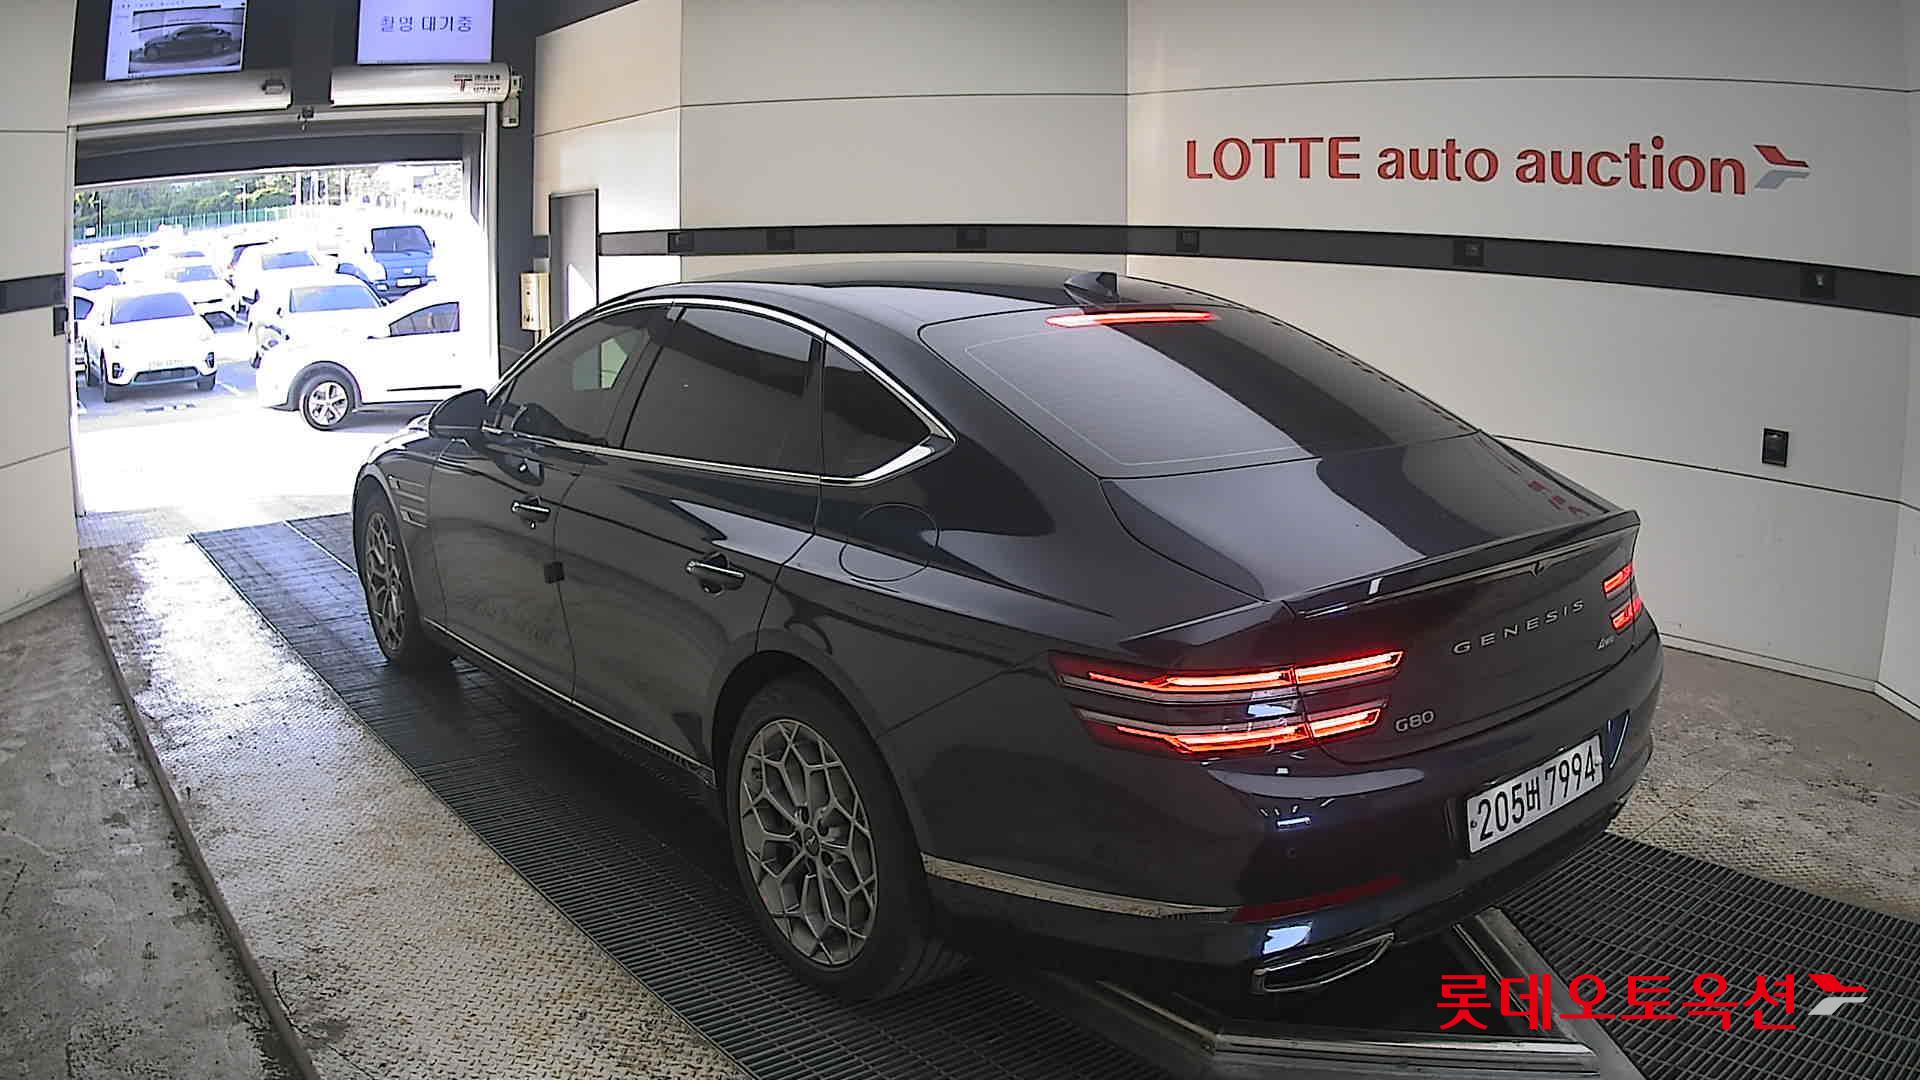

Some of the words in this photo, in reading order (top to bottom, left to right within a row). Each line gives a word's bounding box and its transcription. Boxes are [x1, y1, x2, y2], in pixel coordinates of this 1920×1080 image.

[422, 16, 473, 32] 대기중
[1186, 136, 1361, 180] LOTTE
[1377, 139, 1499, 182] auto
[1515, 135, 1746, 195] auction
[1452, 599, 1585, 655] GENESIS
[1395, 710, 1435, 732] G80
[1544, 745, 1596, 806] 7994
